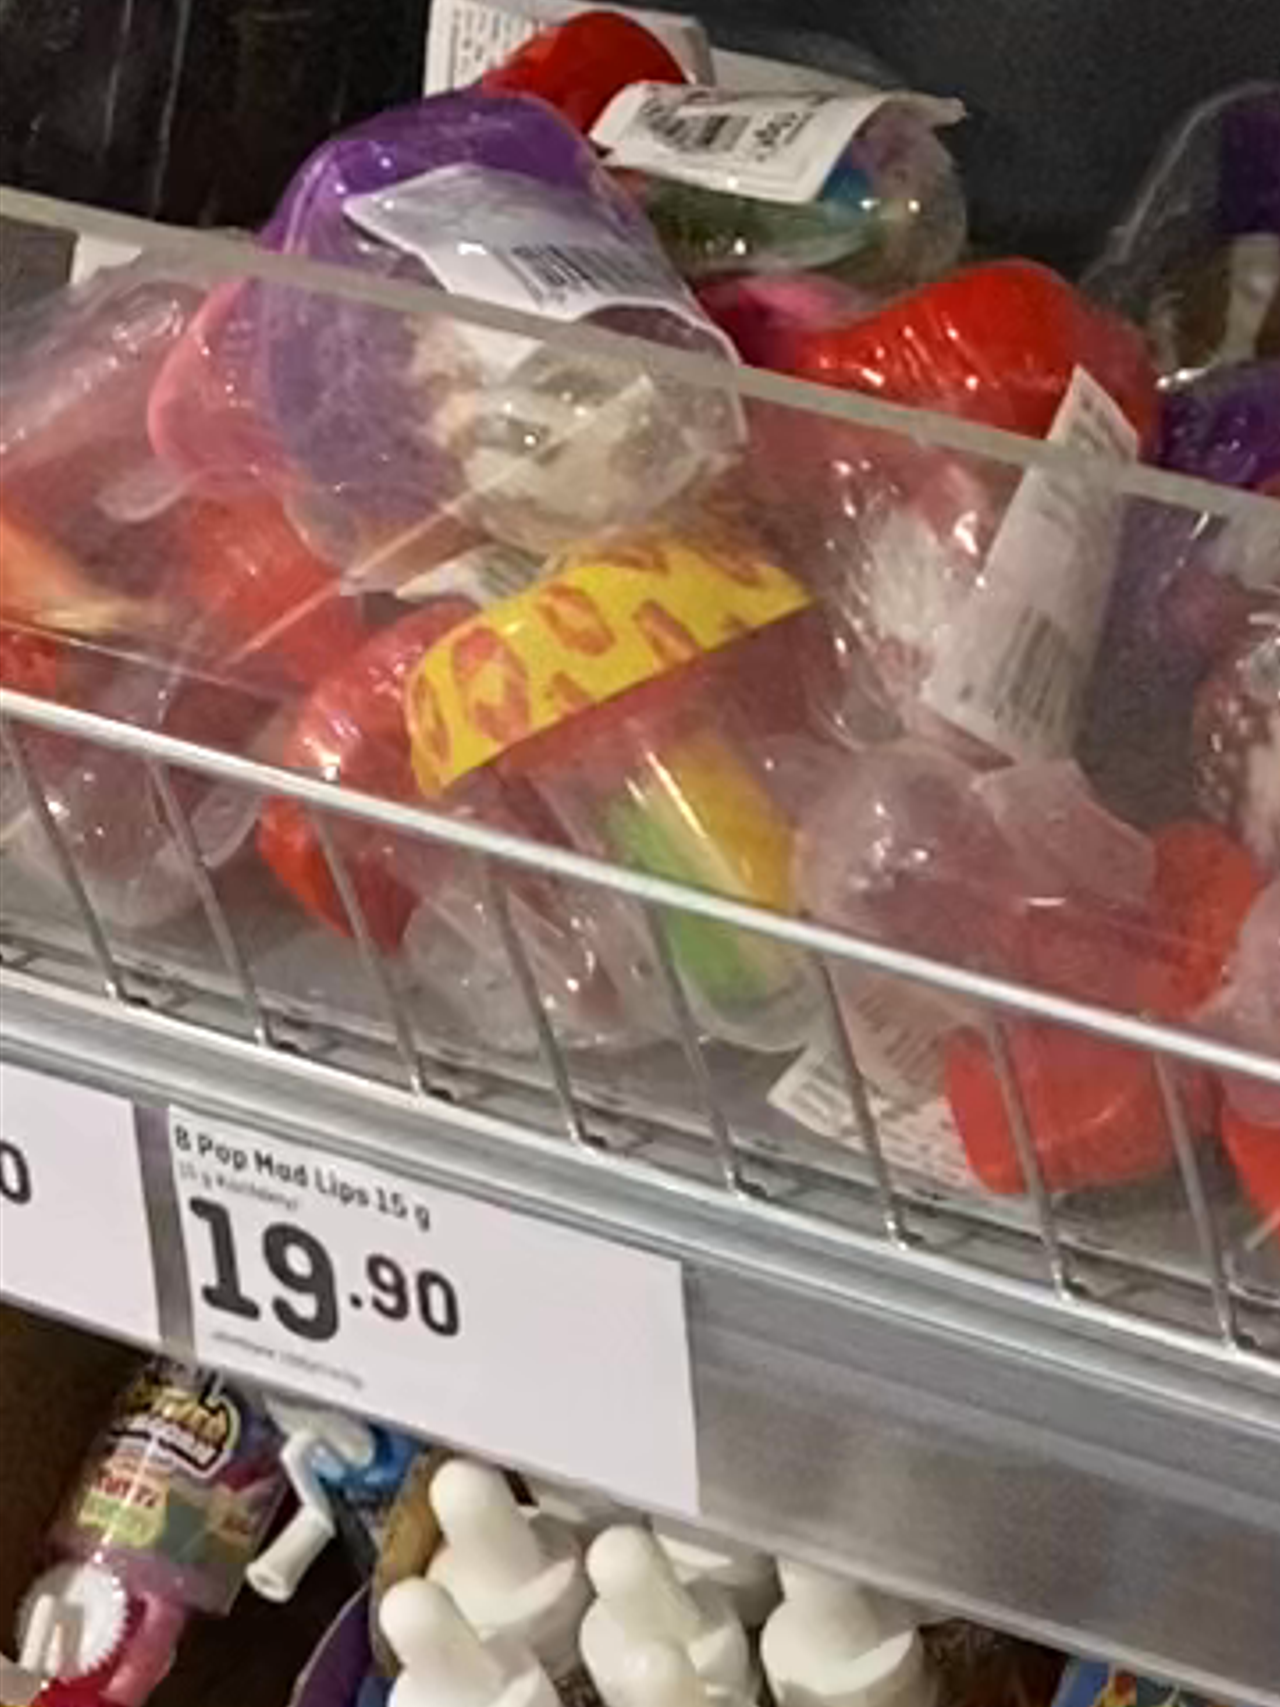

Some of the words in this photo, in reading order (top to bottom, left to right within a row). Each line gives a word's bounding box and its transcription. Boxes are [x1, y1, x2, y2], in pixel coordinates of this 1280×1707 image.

[197, 1133, 248, 1171] Pop
[254, 1150, 309, 1187] Mad
[315, 1167, 370, 1208] Lips
[375, 1186, 409, 1219] 15
[415, 1204, 431, 1233] g
[190, 1196, 460, 1342] 19.90
